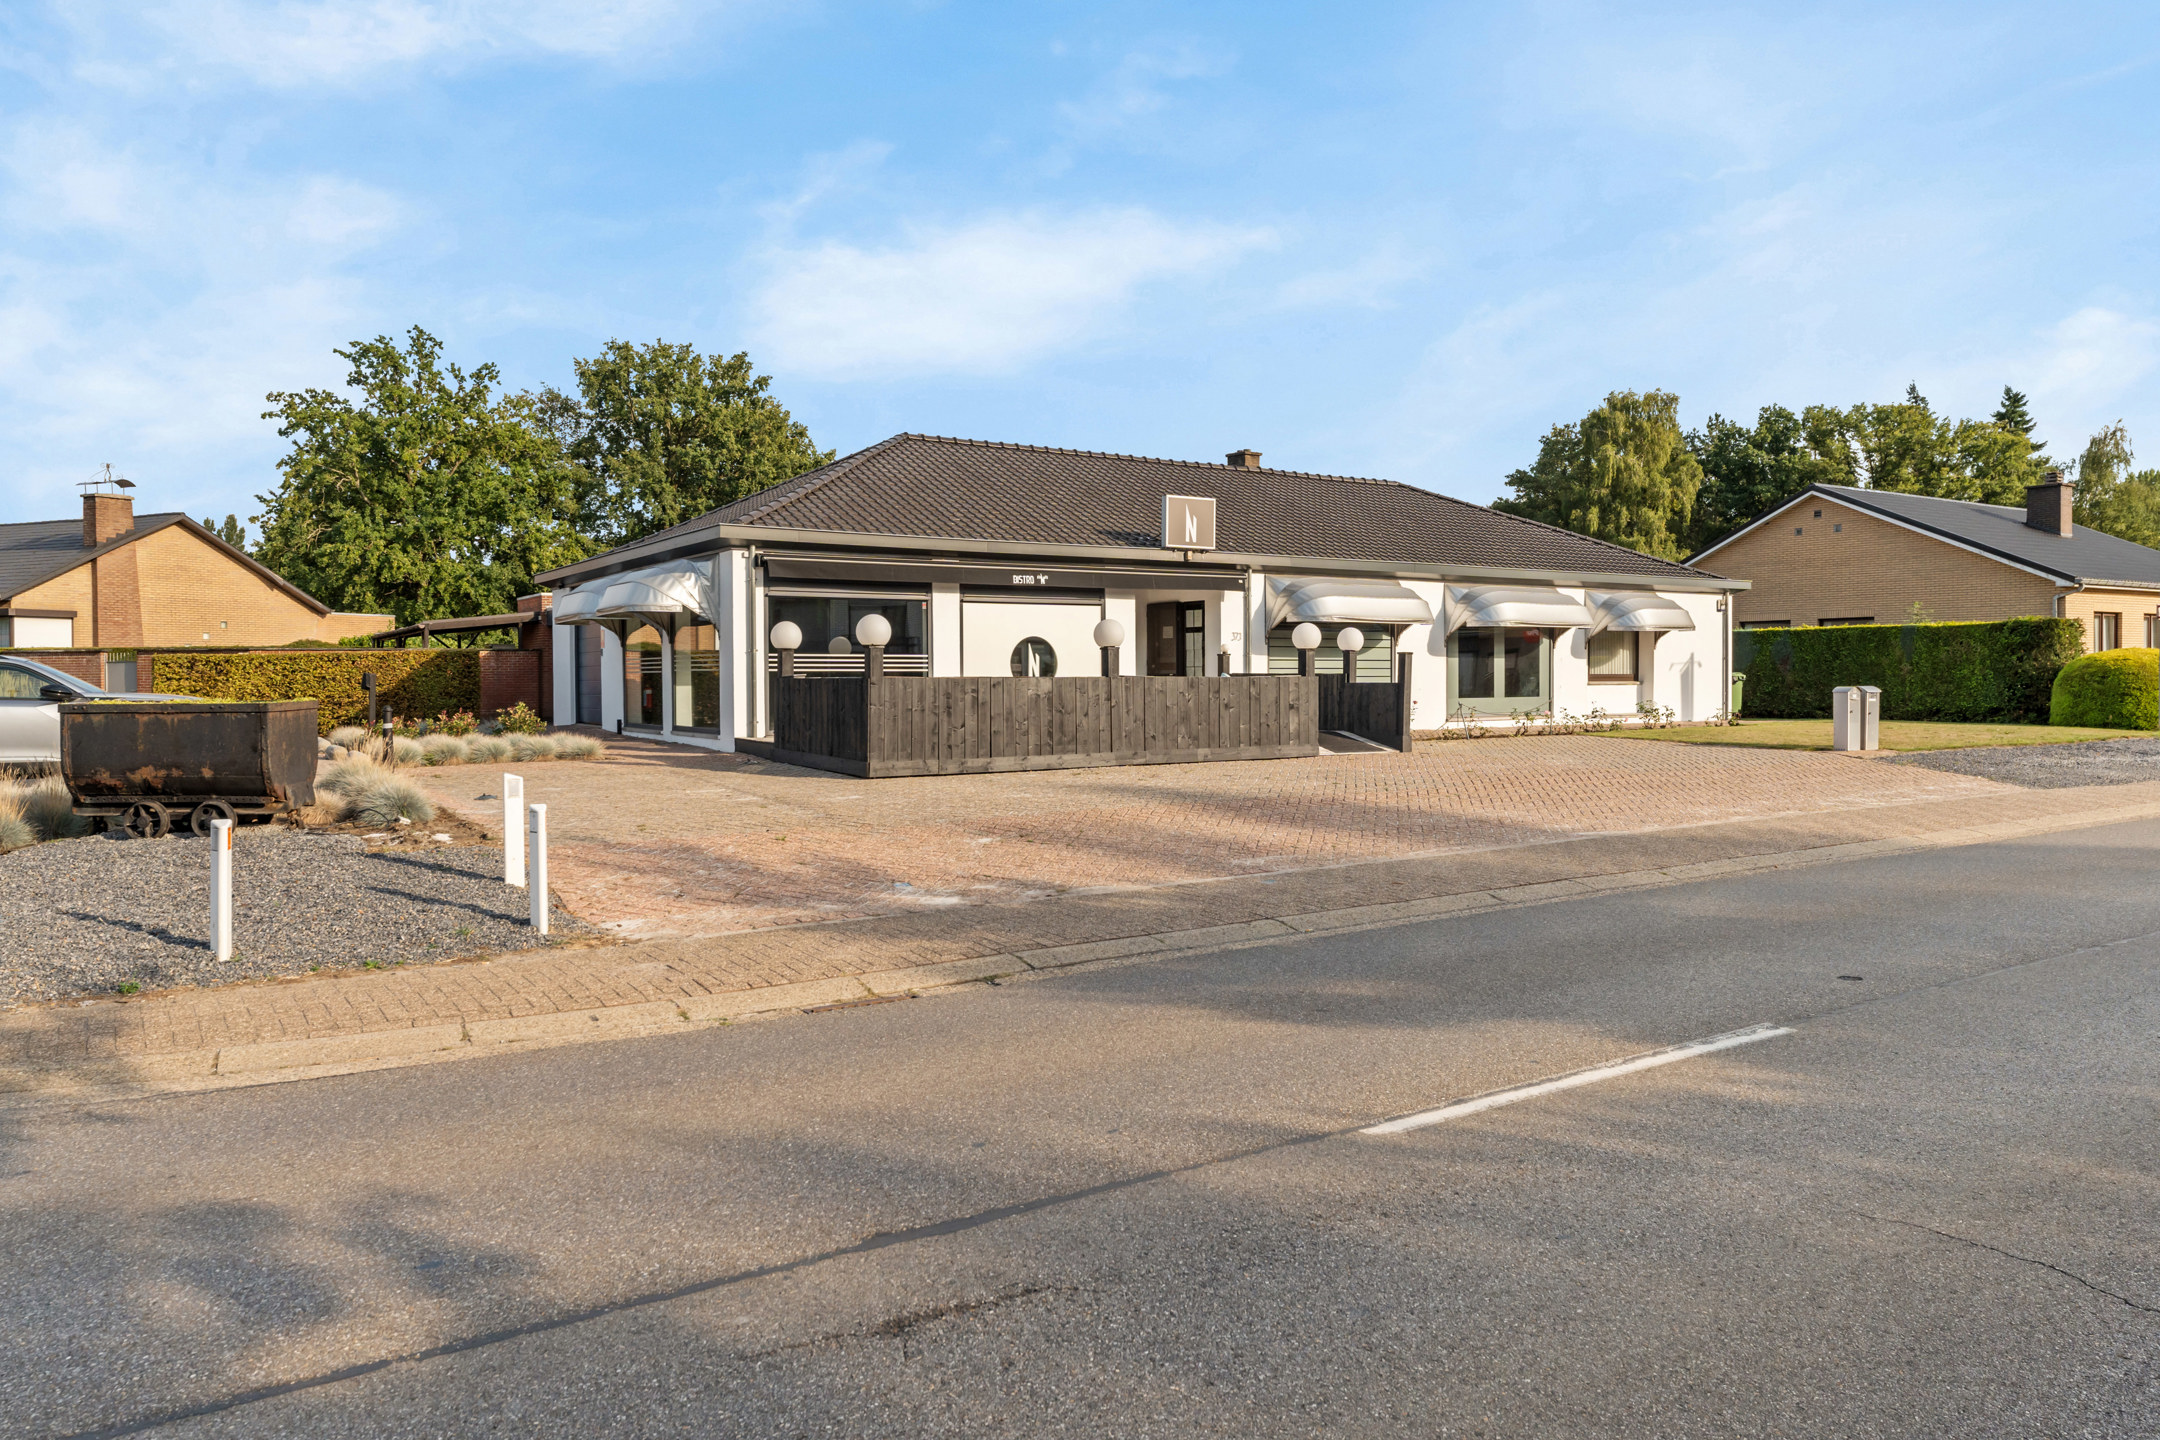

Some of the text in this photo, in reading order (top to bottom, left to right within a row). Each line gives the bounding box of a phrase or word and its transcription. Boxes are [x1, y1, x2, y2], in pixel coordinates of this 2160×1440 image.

[1185, 503, 1197, 543] N
[1012, 574, 1035, 585] BISTRO
[1028, 642, 1040, 677] N
